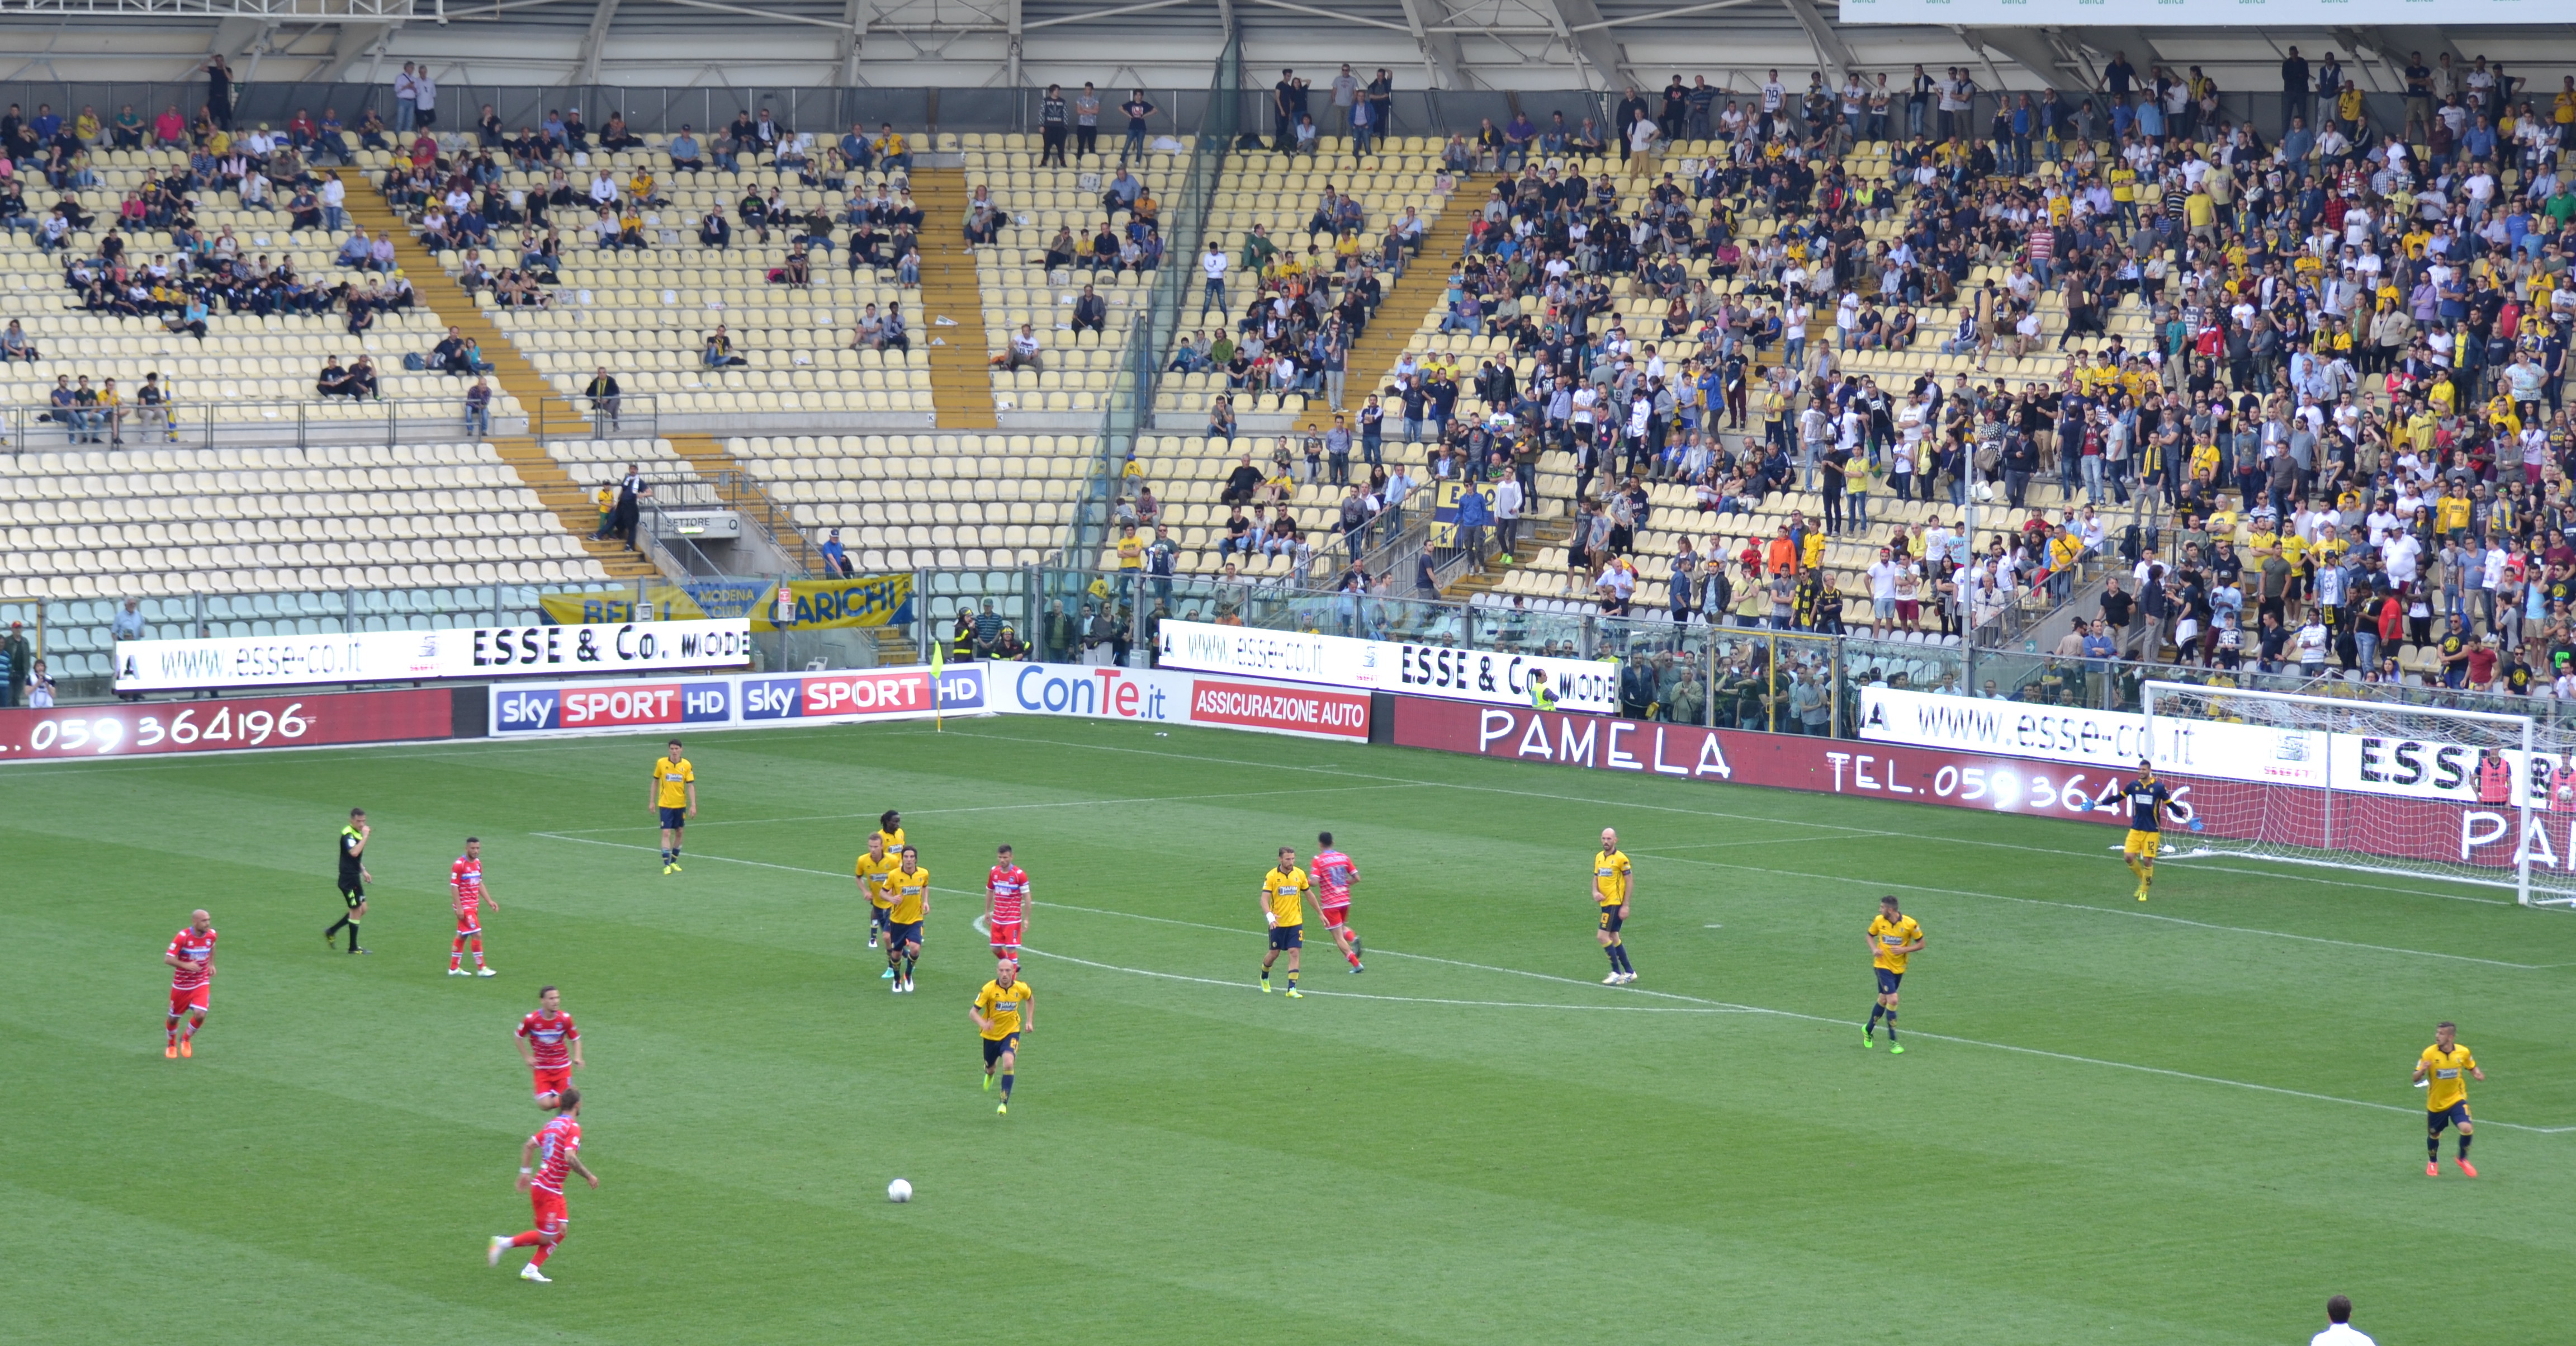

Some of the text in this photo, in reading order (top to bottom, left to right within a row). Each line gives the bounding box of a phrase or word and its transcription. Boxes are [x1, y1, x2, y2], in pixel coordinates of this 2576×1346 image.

[729, 519, 738, 530] Q
[699, 589, 755, 602] MODENA
[712, 605, 742, 618] CLUB
[162, 636, 362, 678] www.esse-co.it
[473, 627, 564, 666] ESSE
[576, 628, 604, 662] &
[616, 624, 670, 660] Co.
[1188, 633, 1323, 674] www.esse-co.it
[1401, 646, 1470, 689] ESSE
[1478, 655, 1500, 692] &
[504, 689, 725, 728] sky SPORT HD
[748, 678, 977, 716] sky SPORT HD
[1016, 665, 1166, 720] ConTe.it
[1195, 689, 1365, 727] ASSICURAZIONE AUTO
[31, 703, 307, 753] 059 364196
[1480, 708, 1731, 779] PAMELA
[1826, 752, 1925, 795] TEL.
[1934, 766, 2018, 809] 059
[2462, 810, 2576, 871] PA
